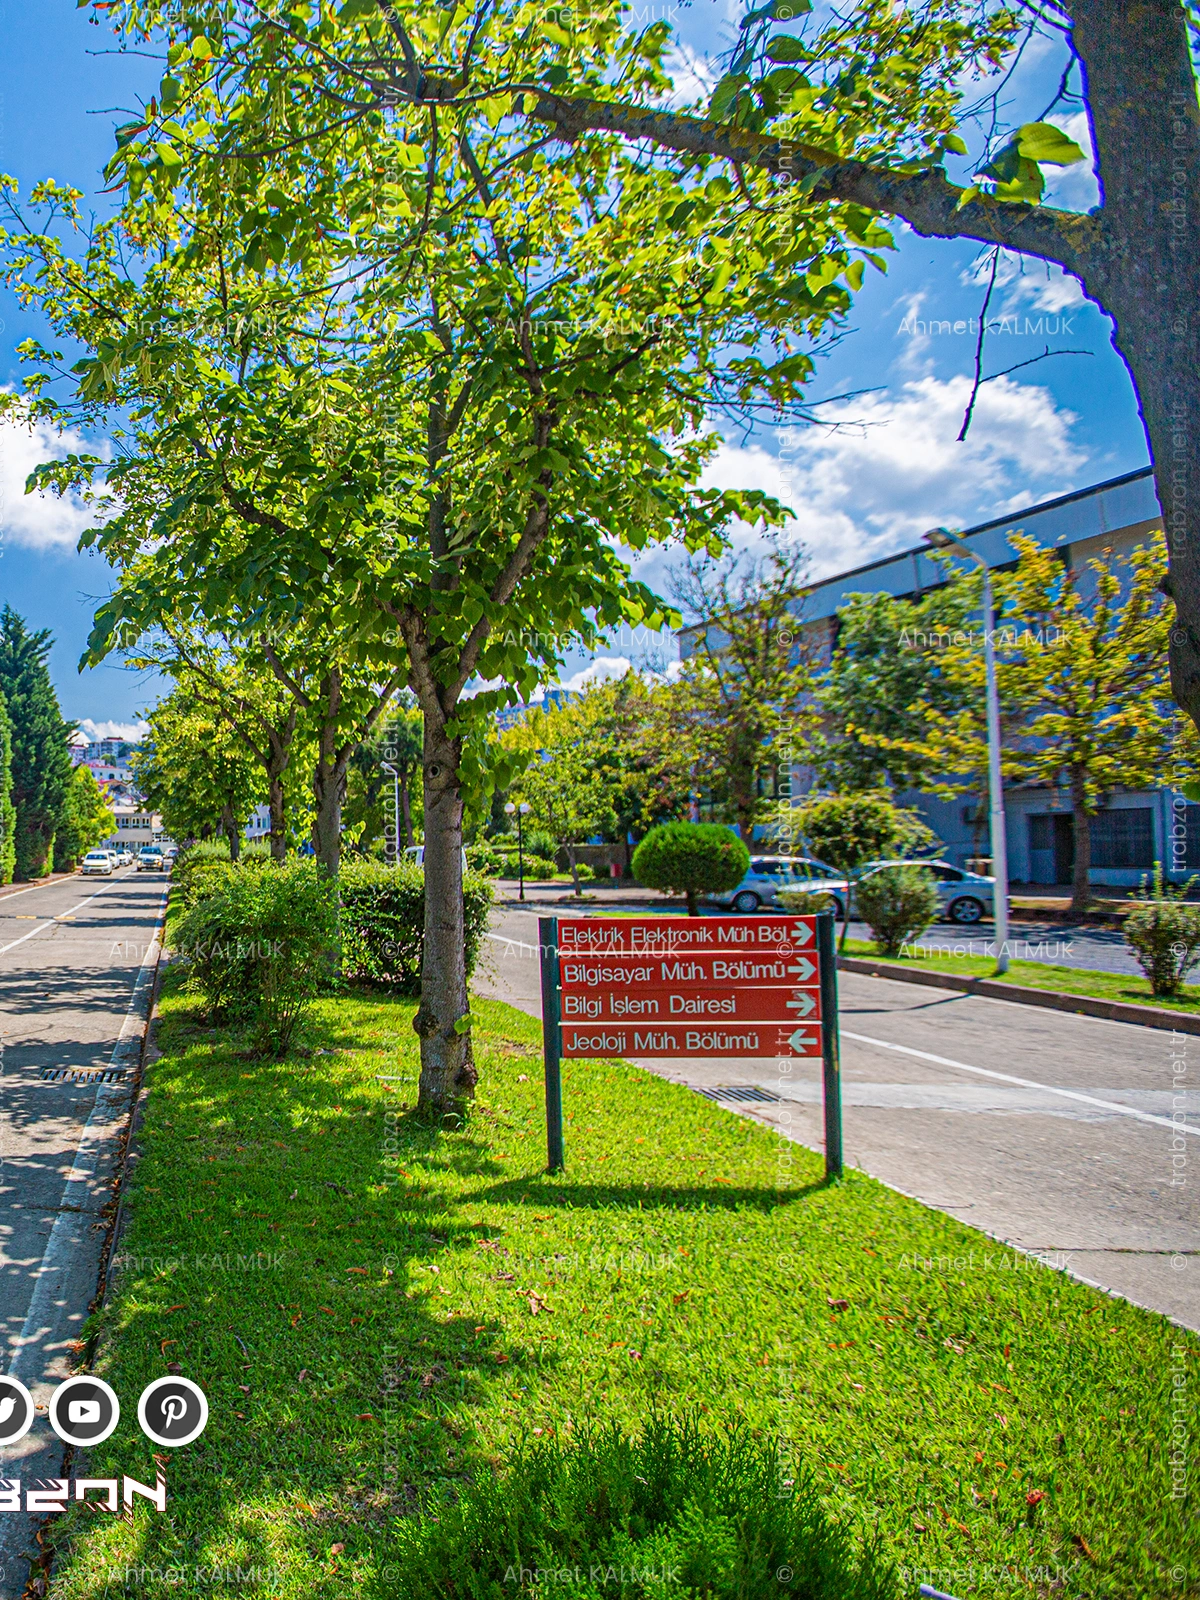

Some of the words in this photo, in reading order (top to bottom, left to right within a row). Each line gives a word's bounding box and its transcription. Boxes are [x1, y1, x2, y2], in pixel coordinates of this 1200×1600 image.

[561, 926, 624, 943] Elektrik
[631, 926, 714, 943] Elektronik
[718, 925, 755, 943] Müh
[758, 925, 791, 942] Böl.
[564, 964, 654, 987] Bilgisayar
[661, 961, 708, 981] Müh.
[713, 960, 786, 979] Bölümü
[565, 995, 602, 1018] Bilgi
[610, 993, 659, 1017] İşlem
[669, 994, 736, 1014] Dairesi
[567, 1031, 627, 1054] Jeoloji
[634, 1031, 680, 1051] Müh.
[685, 1031, 759, 1050] Bölümü
